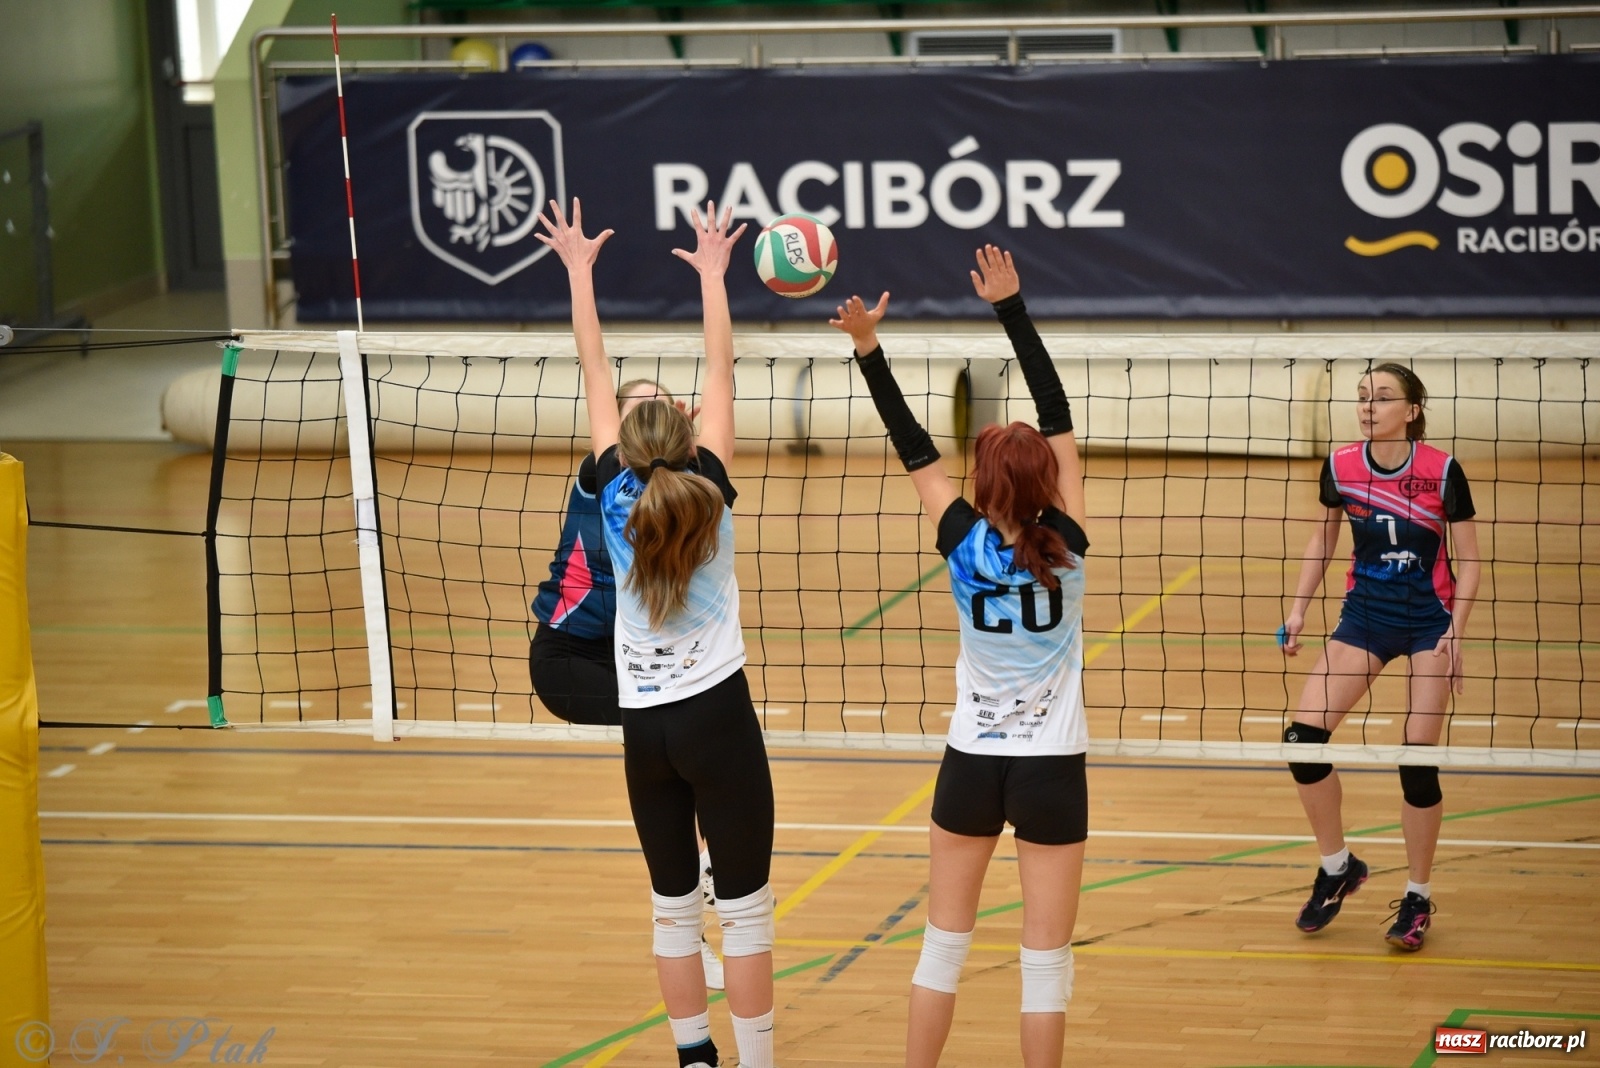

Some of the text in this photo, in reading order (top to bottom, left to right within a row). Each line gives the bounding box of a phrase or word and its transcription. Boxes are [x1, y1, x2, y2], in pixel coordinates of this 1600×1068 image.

[653, 135, 1125, 231] RACIBÓRZ
[1341, 121, 1600, 218] OSiR
[783, 232, 804, 266] RLPS
[1375, 514, 1398, 546] 7
[971, 571, 1063, 634] 20
